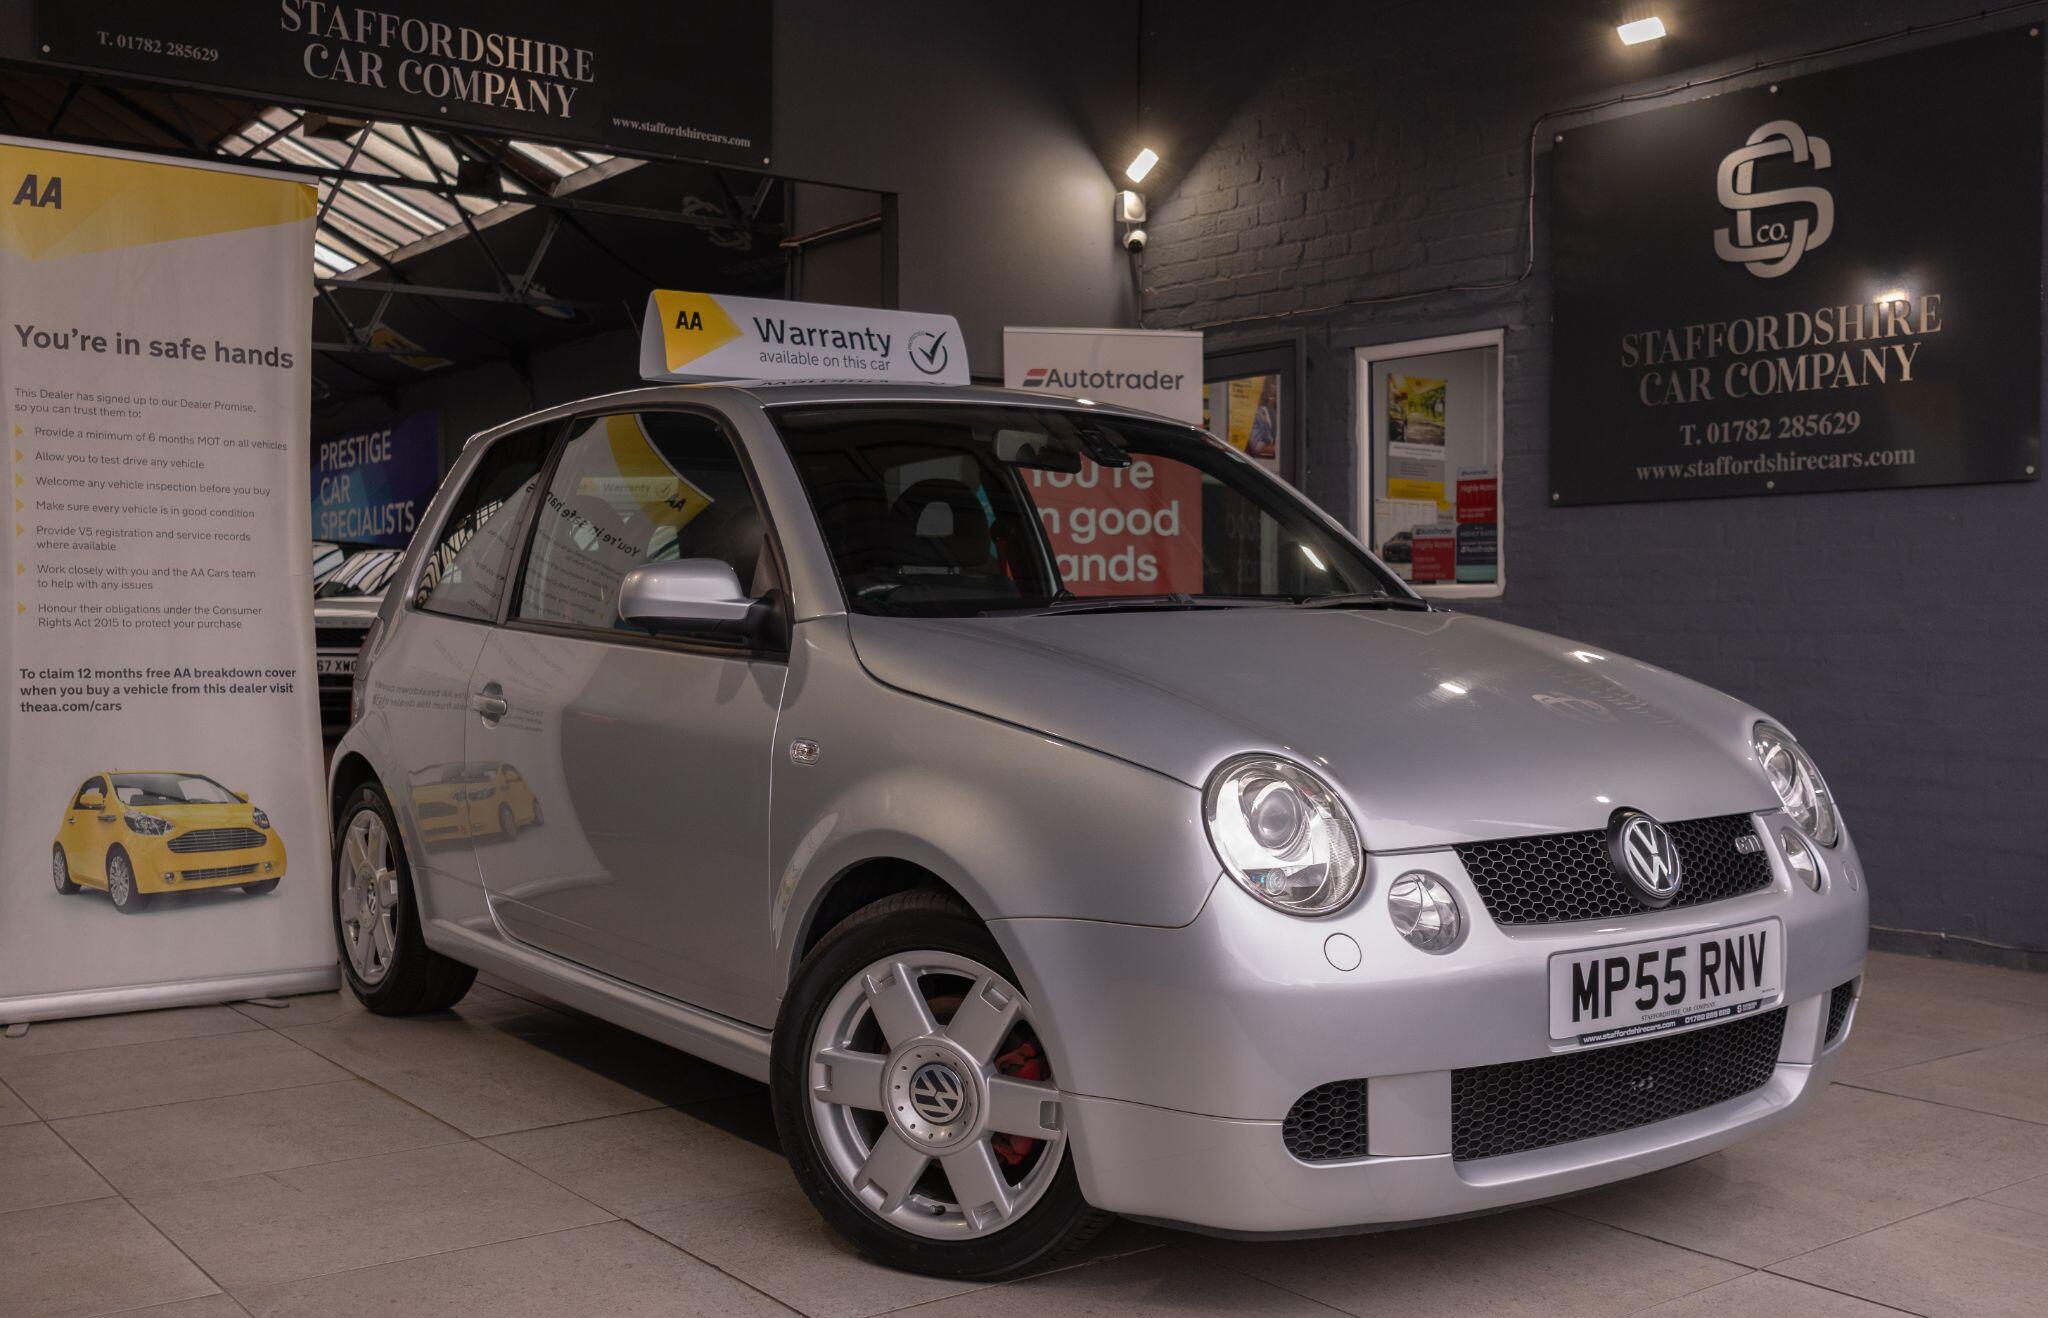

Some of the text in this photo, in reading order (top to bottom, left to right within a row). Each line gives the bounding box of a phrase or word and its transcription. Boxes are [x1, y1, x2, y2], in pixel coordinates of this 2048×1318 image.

[97, 30, 219, 62] T. 01782 285629
[280, 0, 595, 83] STAFFORDSHIRE
[302, 44, 579, 119] CAR COMPANY
[612, 115, 751, 149] www.staffordshirecars.com
[12, 174, 64, 209] AA
[675, 311, 703, 331] AA
[1621, 293, 1943, 369] STAFFORDSHIRE
[14, 324, 294, 368] You're in safe hands
[753, 315, 892, 357] Warranty
[759, 350, 890, 372] available on this car
[1639, 342, 1922, 407] CAR COMPANY
[1045, 369, 1184, 391] Autotrader
[14, 388, 256, 414] This Dealer has signed up to our Dealer Promise,
[14, 404, 142, 419] so you can trust them to:
[35, 427, 75, 439] Provide
[86, 430, 133, 442] minimum
[135, 431, 147, 441] of
[149, 432, 156, 441] 6
[158, 433, 195, 444] months
[197, 435, 220, 445] MOT
[223, 438, 236, 446] on
[238, 437, 249, 448] all
[251, 439, 288, 451] vehicles
[1680, 411, 1861, 446] T. 01782 285629
[35, 451, 204, 470] Allow you to test drive any vehicle
[319, 430, 392, 472] PRESTIGE
[1636, 448, 1916, 481] www.staffordshirecars.com
[35, 477, 271, 498] Welcome any vehicle inspection before you buy
[320, 474, 350, 508] CAR
[36, 499, 1181, 545] Make sure every vehicle is in good condition
[36, 525, 251, 541] Provide V5 registration and service records
[319, 501, 415, 541] SPECIALISTS
[1037, 499, 1181, 545] n good
[37, 540, 116, 551] where available
[37, 564, 256, 579] Work closely with you and the AA Cars team
[1056, 544, 1159, 582] ands
[37, 579, 153, 592] to help with any issues
[38, 604, 261, 617] Honour their obligations under the Consumer
[38, 618, 242, 631] Rights Act 2015 to protect your purchase
[20, 667, 296, 680] To claim 12 months free AA breakdown cover
[20, 682, 293, 698] when you buy a vehicle from this dealer visit
[20, 700, 122, 714] theaa.com/cars
[1572, 931, 1766, 1023] MP55 RNV
[1582, 1020, 1677, 1044] www.staffordshirecars.com
